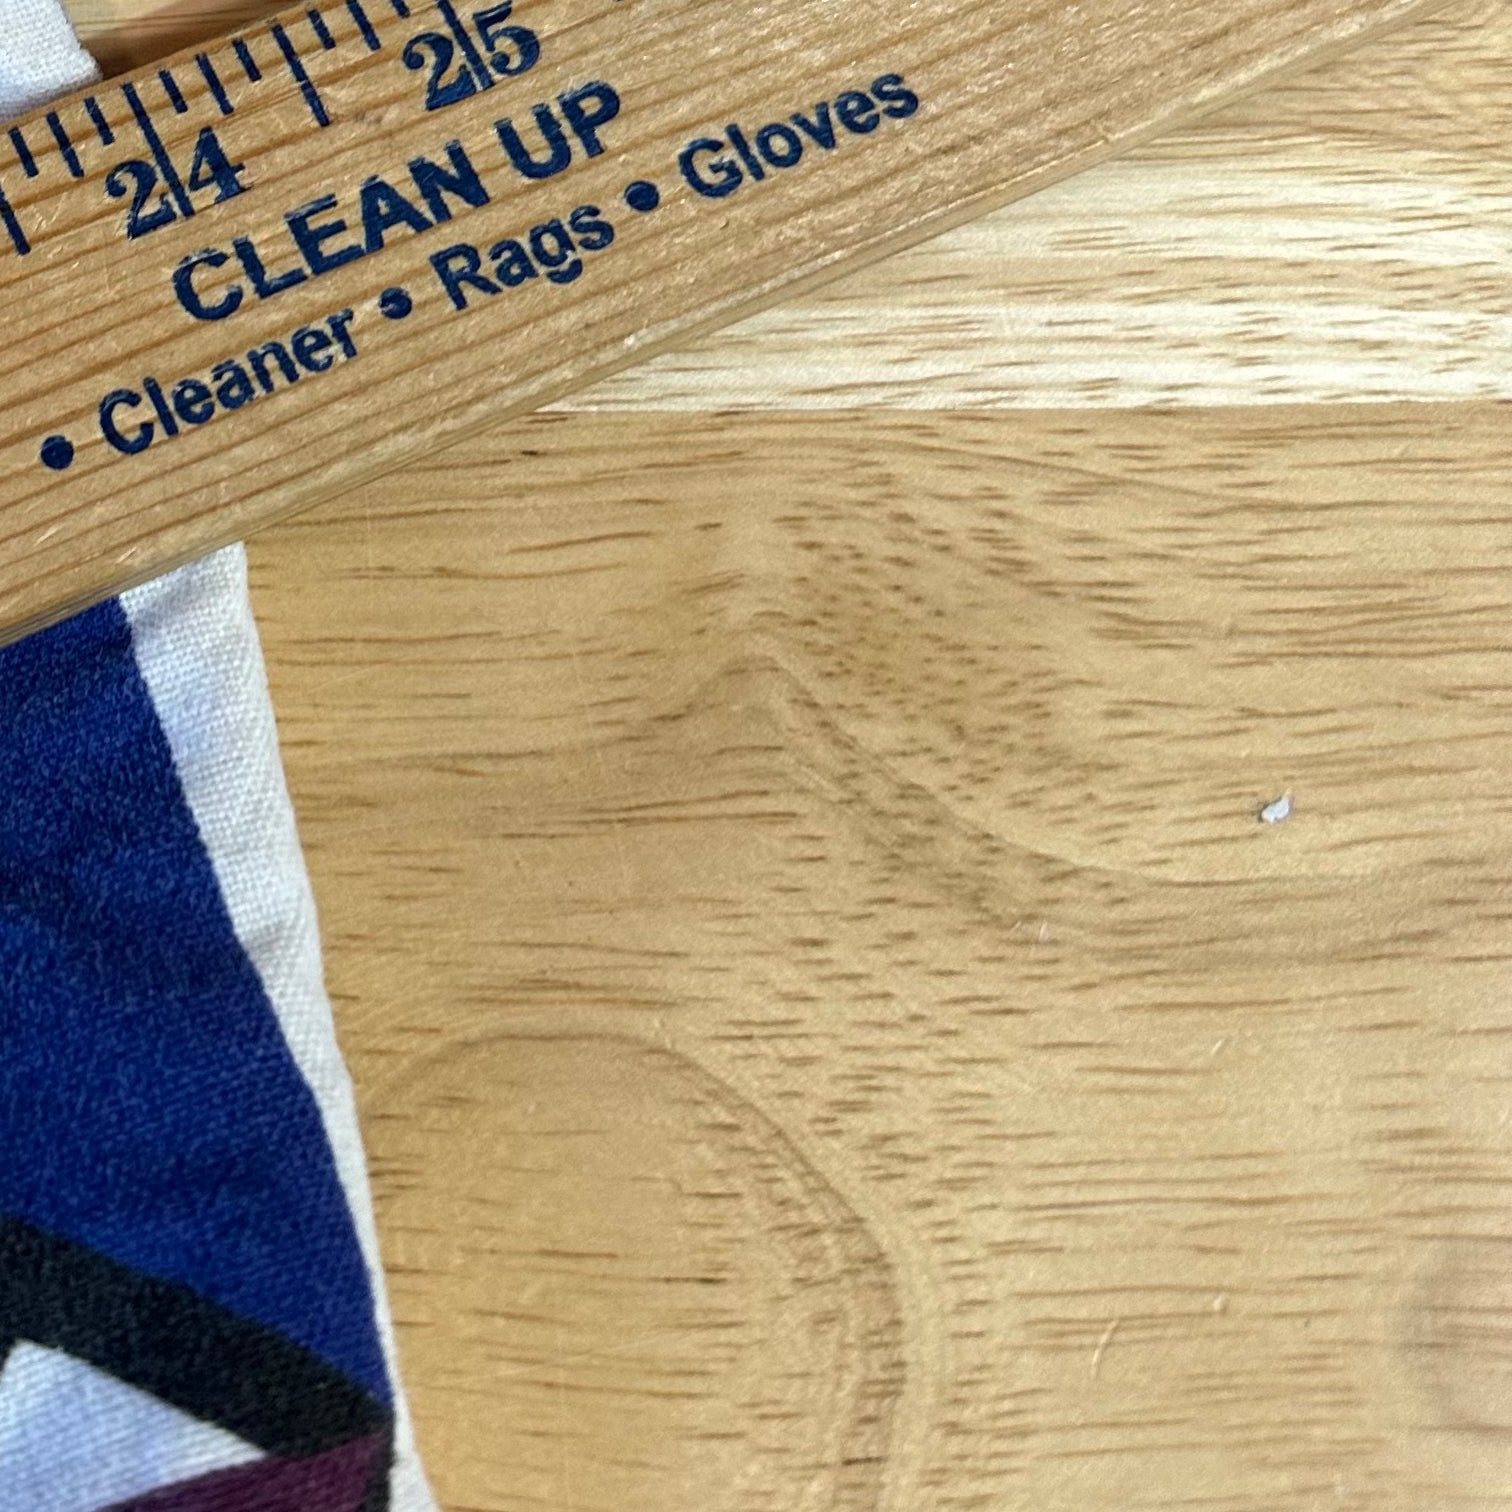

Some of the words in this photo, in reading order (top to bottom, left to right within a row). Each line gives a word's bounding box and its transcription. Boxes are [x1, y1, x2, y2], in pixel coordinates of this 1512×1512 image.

[105, 126, 246, 240] 24
[403, 1, 540, 111] 25
[172, 140, 489, 322] CLEAN
[496, 81, 622, 180] UP
[98, 308, 359, 455] Cleaner
[430, 205, 615, 311] Rags
[679, 72, 920, 198] Gloves
